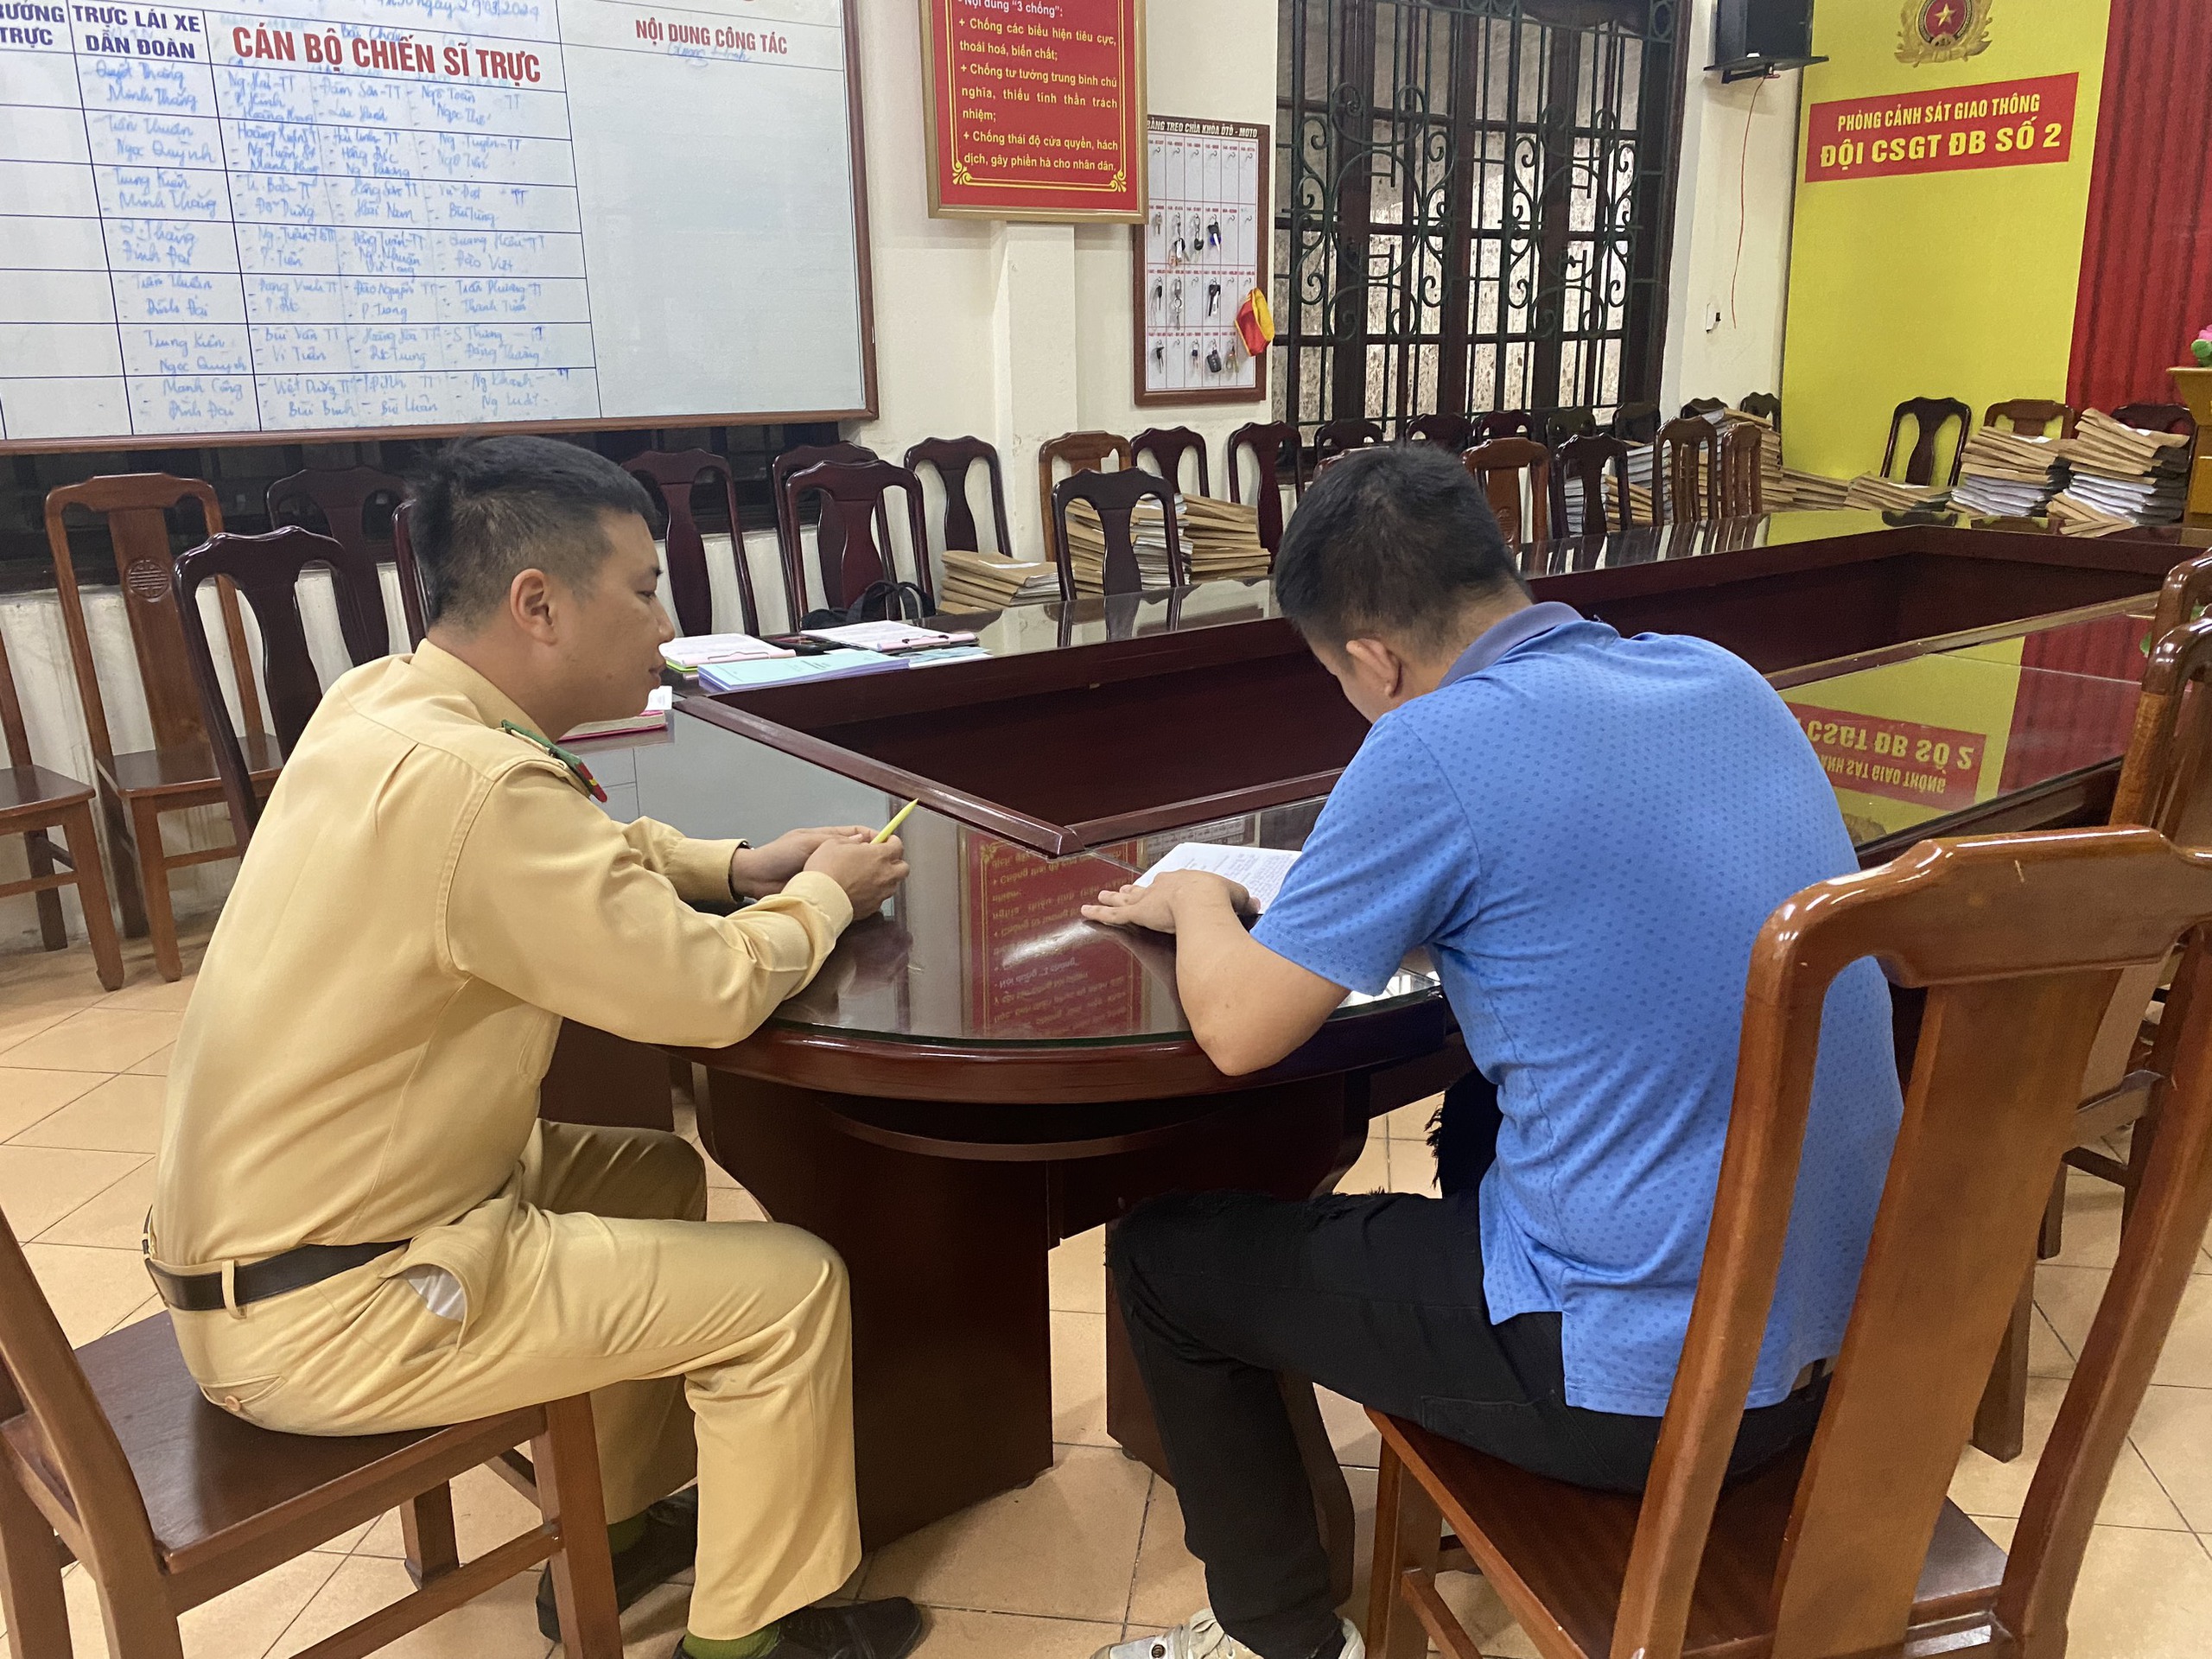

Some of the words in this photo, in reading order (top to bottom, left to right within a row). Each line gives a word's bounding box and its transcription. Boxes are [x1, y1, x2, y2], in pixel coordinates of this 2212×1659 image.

[72, 5, 128, 29] TRỰC
[135, 8, 168, 29] LÁI
[175, 14, 201, 33] XE
[969, 15, 1002, 35] Chống
[1007, 22, 1024, 34] các
[1027, 23, 1048, 37] biểu
[1052, 28, 1072, 40] hiện
[1076, 30, 1093, 42] tiêu
[1096, 35, 1116, 47] cực,
[0, 27, 54, 48] TRỰC
[85, 28, 131, 54] DẪN
[137, 38, 196, 60] ĐOÀN
[635, 17, 664, 46] NỘI
[668, 23, 711, 47] DUNG
[715, 27, 755, 51] CÔNG
[760, 31, 788, 54] TÁC
[232, 22, 296, 61] CÁN
[303, 27, 343, 73] BỘ
[352, 34, 435, 73] CHIẾN
[443, 41, 470, 77] SĨ
[475, 48, 542, 86] TRỰC
[959, 40, 985, 54] thoái
[988, 42, 1009, 56] hoá,
[1012, 43, 1032, 57] biến
[1034, 46, 1058, 61] chất;
[969, 61, 1002, 79] Chống
[1006, 67, 1017, 78] tư
[1019, 67, 1048, 84] tưởng
[1051, 72, 1076, 86] trung
[1078, 73, 1098, 86] bình
[1101, 76, 1117, 88] chủ
[962, 86, 995, 99] nghĩa,
[1002, 87, 1030, 101] thiếu
[1064, 91, 1086, 106] thần
[1092, 97, 1117, 109] trách
[963, 109, 996, 124] nhiệm;
[1838, 111, 1881, 132] PHÒNG
[1885, 103, 1922, 127] CẢNH
[1924, 100, 1951, 123] SÁT
[1954, 99, 1988, 120] GIAO
[1992, 92, 2040, 117] THÔNG
[973, 129, 1005, 145] Chống
[1007, 132, 1026, 144] thái
[1028, 134, 1040, 148] độ
[1043, 137, 1061, 147] cửa
[1064, 136, 1095, 150] quyền,
[1096, 138, 1118, 151] hách
[1166, 121, 1185, 133] TREO
[1239, 127, 1258, 138] MOTO
[1820, 138, 1864, 171] ĐỘI
[1872, 134, 1942, 163] CSGT
[1948, 130, 1986, 156] ĐB
[1995, 115, 2037, 152] SỐ
[2043, 122, 2063, 148] 2
[963, 153, 988, 167] dịch,
[990, 154, 1007, 168] gây
[1011, 153, 1037, 168] phiền
[1039, 156, 1051, 168] hà
[1053, 157, 1071, 169] cho
[1073, 158, 1095, 171] nhân
[1097, 160, 1116, 172] dân.
